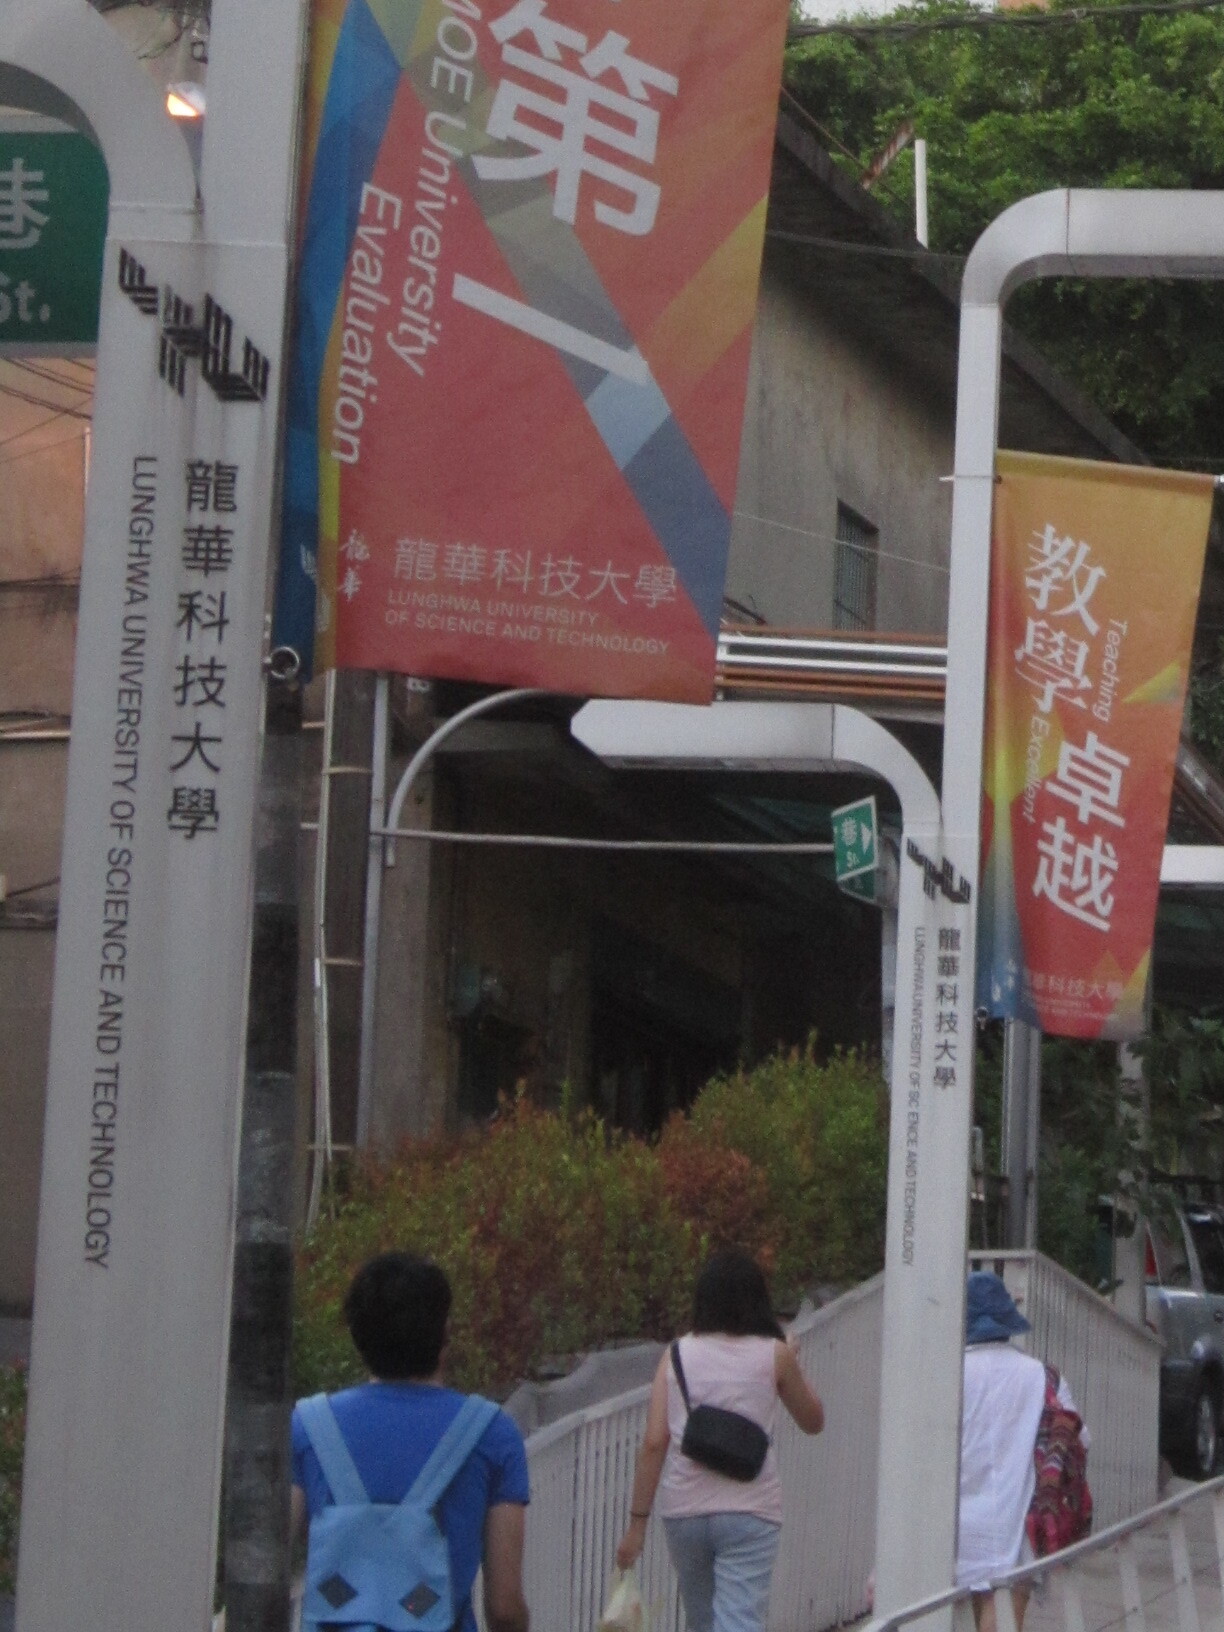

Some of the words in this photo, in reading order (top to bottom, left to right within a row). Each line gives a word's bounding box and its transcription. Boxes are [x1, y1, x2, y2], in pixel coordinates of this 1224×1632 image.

[386, 110, 468, 377] University
[330, 180, 403, 465] Evaluation
[124, 456, 158, 606] LUNGHWA
[394, 537, 677, 609] 龍華科技大學
[167, 459, 239, 840] 龍華科技大學
[384, 609, 409, 627] OF
[414, 611, 497, 638] SCIENCE
[501, 622, 540, 643] AND
[546, 628, 671, 657] TECHNOLOGY
[387, 590, 482, 615] LUNGHWA
[486, 599, 600, 627] UNIVERSITY
[1092, 618, 1128, 722] Teaching
[111, 615, 148, 794] UNIVERSITY
[1022, 715, 1050, 824] Excellent
[109, 800, 136, 841] OF
[100, 847, 133, 982] SCIENCE
[96, 989, 125, 1056] AND
[933, 927, 961, 1090] 龍華科技大學
[84, 1062, 120, 1269] TECHNOLOGY
